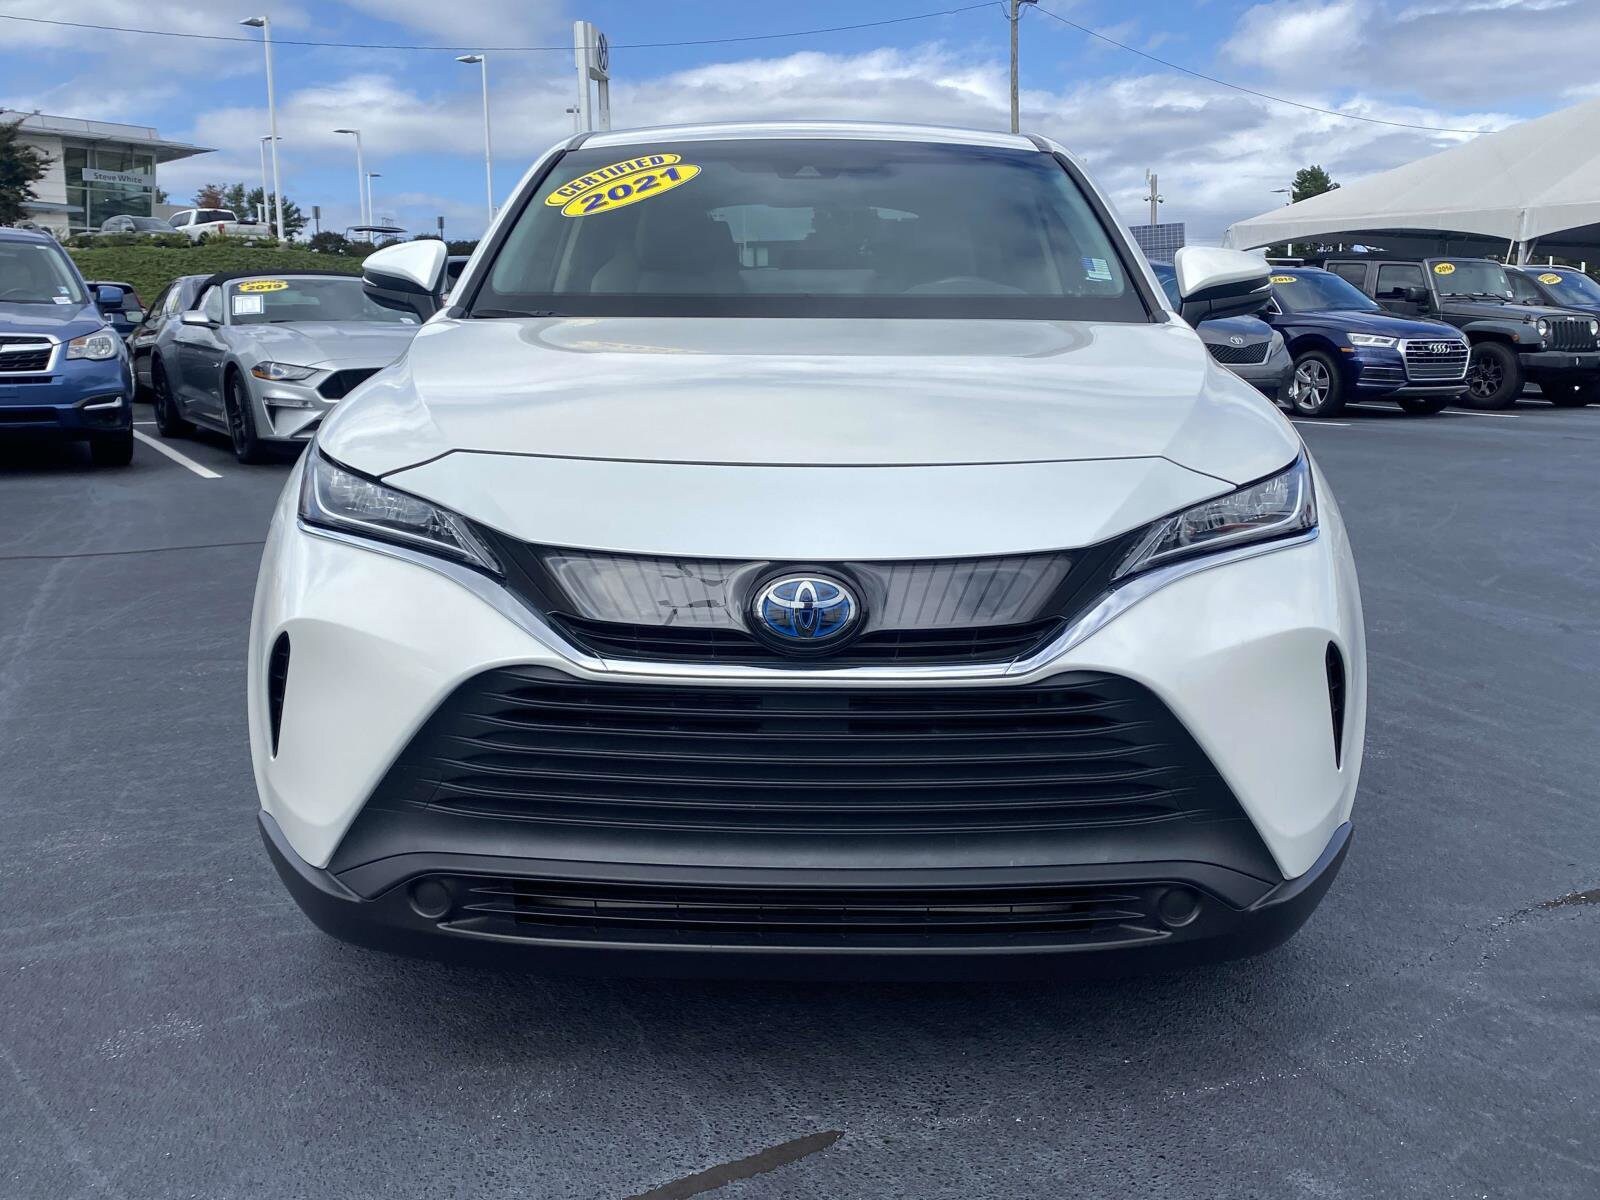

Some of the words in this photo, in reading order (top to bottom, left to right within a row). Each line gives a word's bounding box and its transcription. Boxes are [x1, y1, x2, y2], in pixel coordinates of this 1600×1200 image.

[93, 172, 117, 181] Steve
[118, 174, 143, 184] White
[556, 155, 666, 198] CERTIFIED
[580, 166, 682, 214] 2021
[247, 283, 283, 291] 2019
